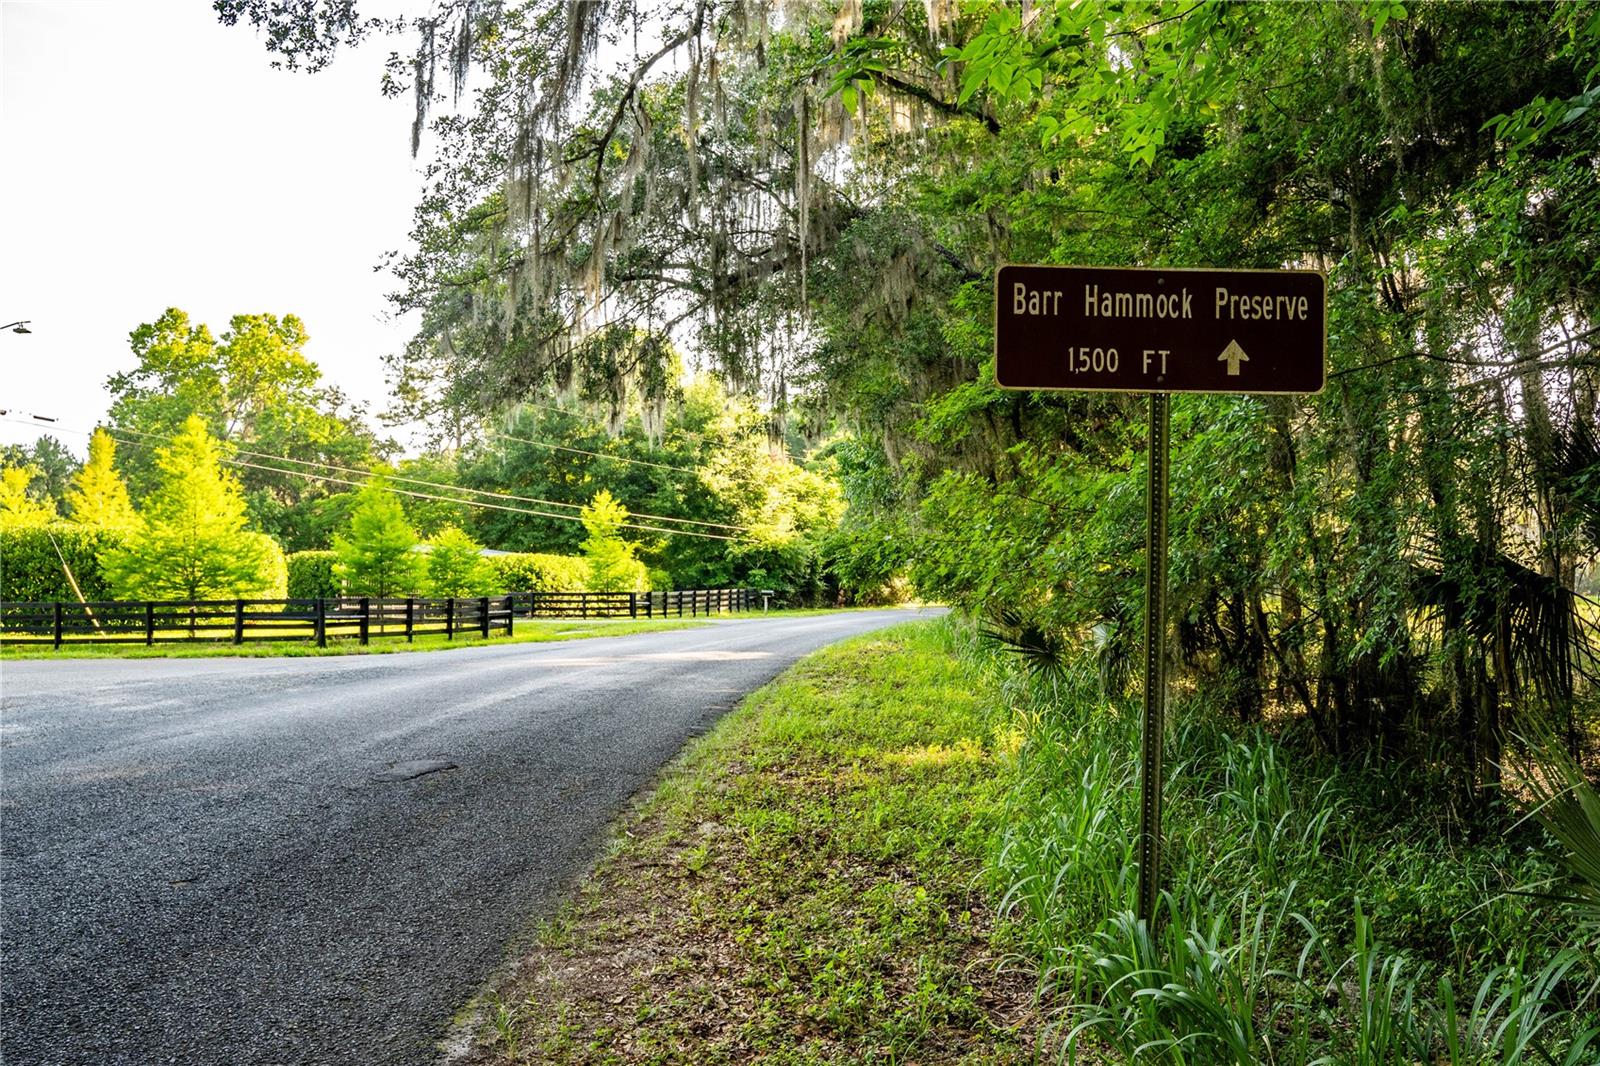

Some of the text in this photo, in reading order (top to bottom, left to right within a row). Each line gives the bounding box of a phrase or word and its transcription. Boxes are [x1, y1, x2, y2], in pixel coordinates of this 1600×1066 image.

[1013, 282, 1309, 320] Barr Hammock Preserve
[1068, 347, 1170, 374] 1,500 FT
